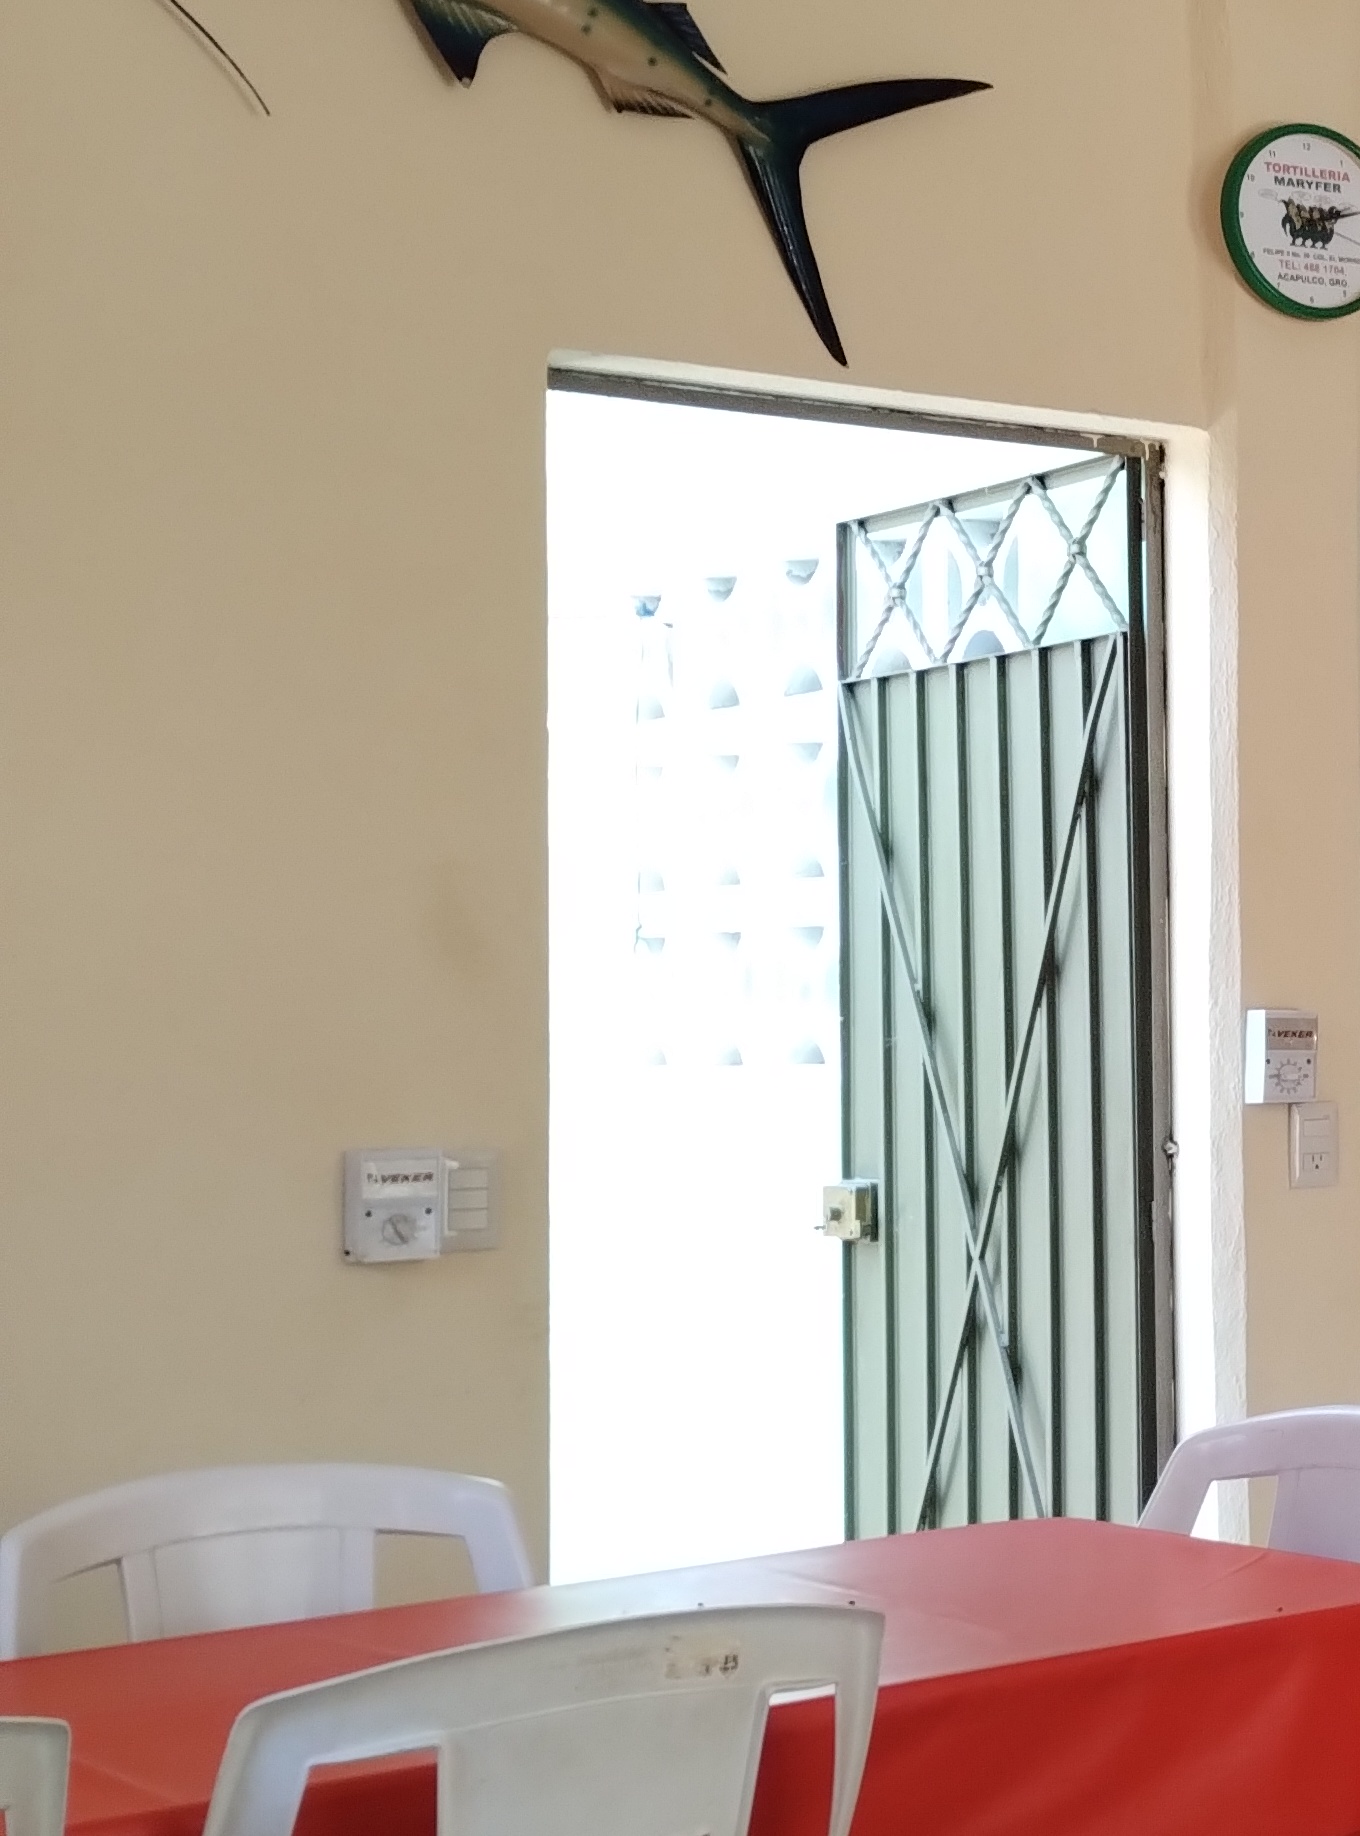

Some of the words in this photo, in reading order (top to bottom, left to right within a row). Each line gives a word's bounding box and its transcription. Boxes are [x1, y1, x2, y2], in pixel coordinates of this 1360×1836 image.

[1264, 161, 1351, 183] TORTILLERIA
[1274, 175, 1342, 194] MARYFER
[1278, 258, 1301, 271] TEL:
